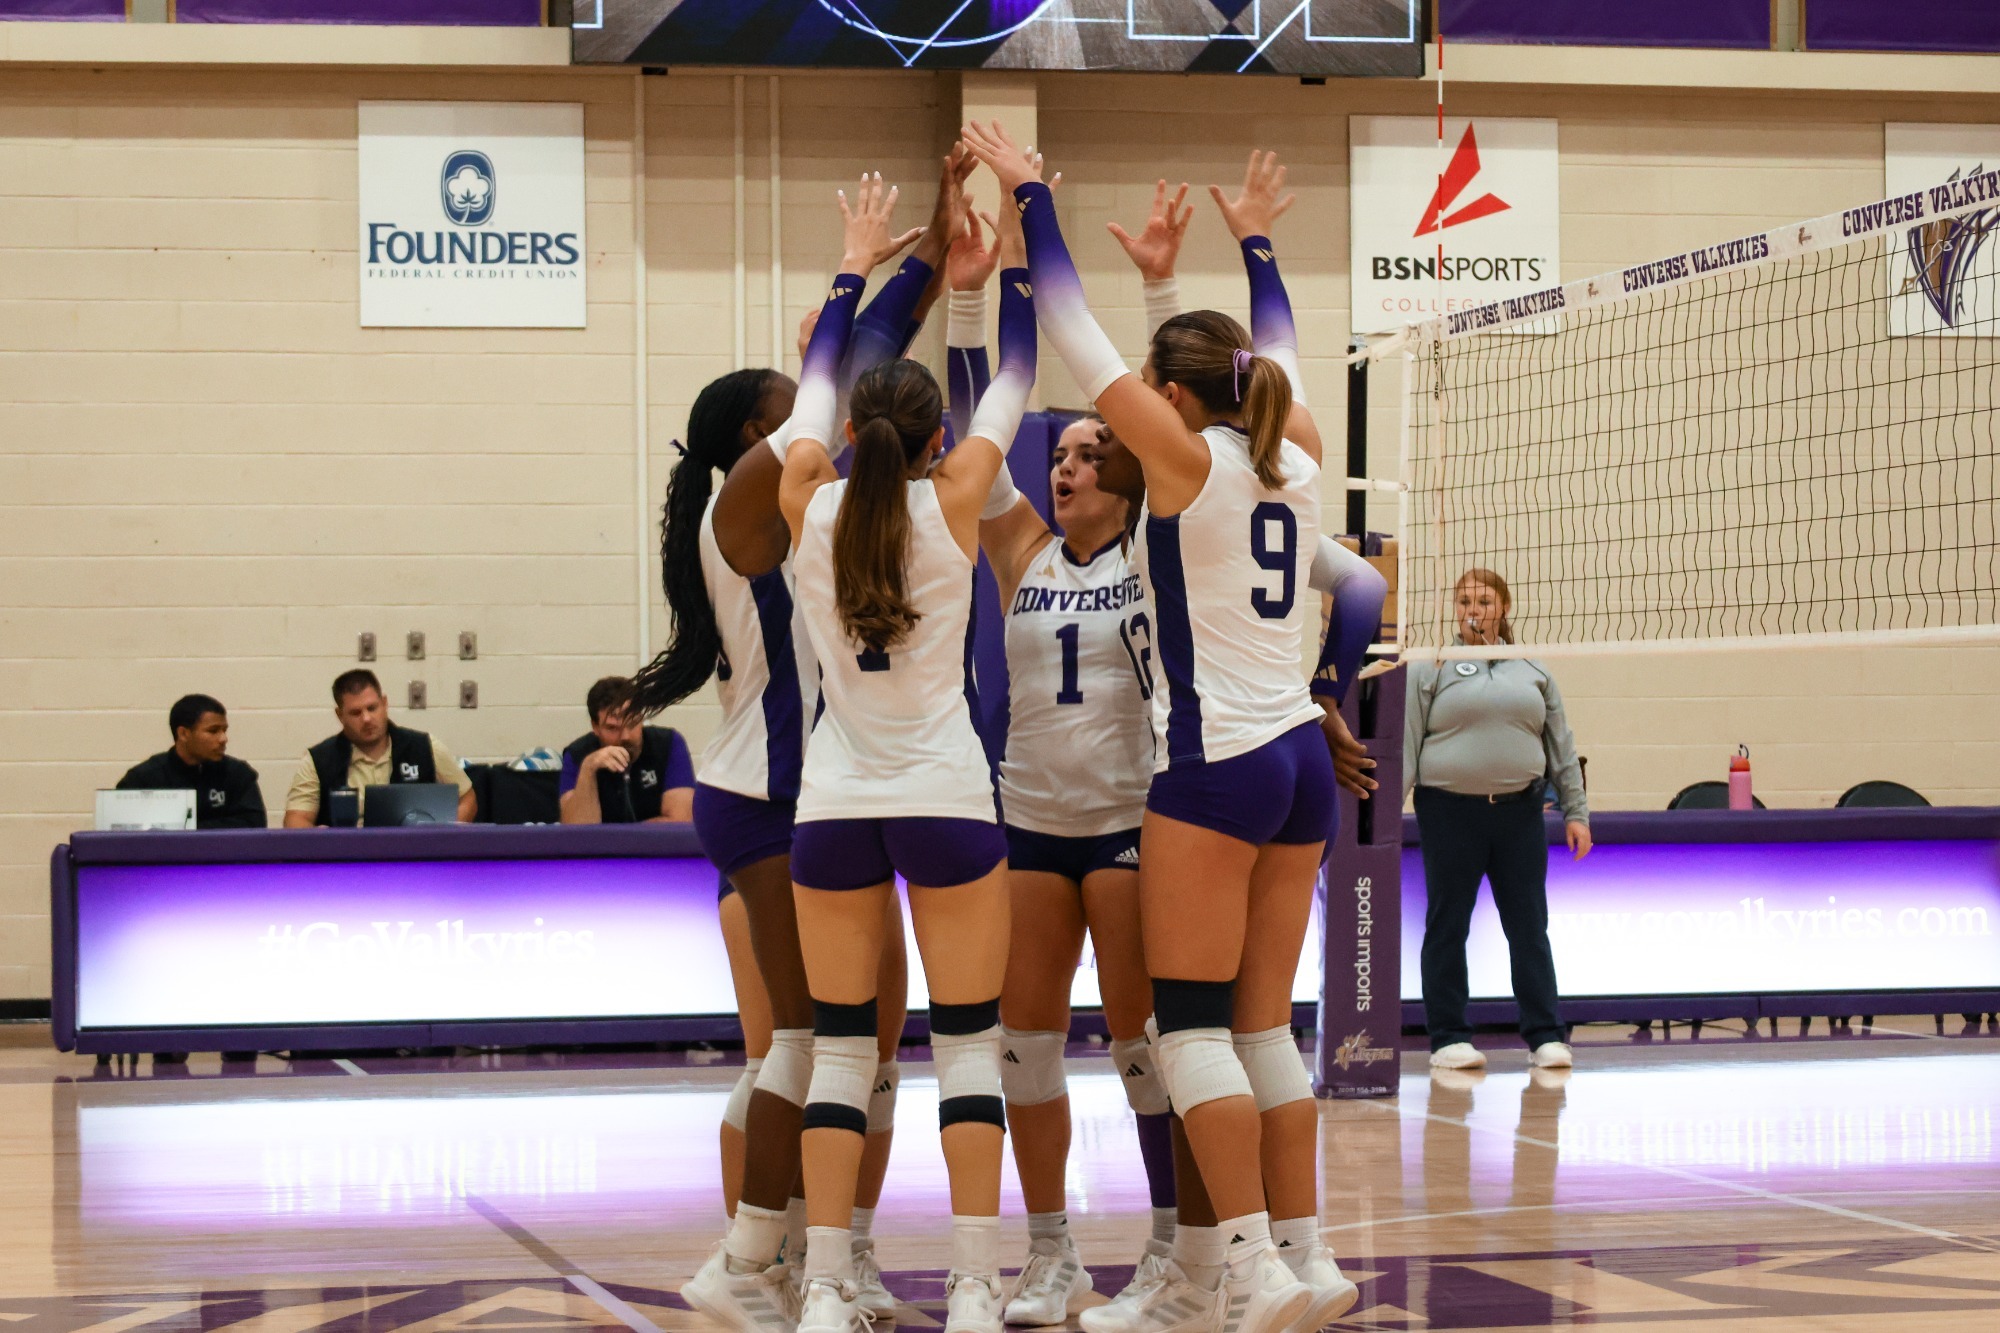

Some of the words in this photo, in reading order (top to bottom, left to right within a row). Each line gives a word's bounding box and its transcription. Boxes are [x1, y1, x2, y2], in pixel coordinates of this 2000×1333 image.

[1842, 191, 1923, 237] CONVERSE
[367, 223, 580, 265] FOUNDERS
[1623, 254, 1688, 292] CONVERSE
[1691, 234, 1768, 274] VALKYRIES
[368, 269, 445, 279] FEDERAL
[453, 269, 515, 279] CREDIT
[526, 269, 578, 279] UNION
[1447, 302, 1501, 334] CONVERSE
[1502, 286, 1566, 321] VALKYRIES
[1250, 501, 1297, 619] 9
[1056, 623, 1083, 705] 1
[1119, 611, 1154, 701] 12
[400, 762, 419, 776] CU
[1354, 876, 1374, 936] sports
[257, 916, 596, 970] #GoValkyries
[1354, 938, 1373, 1012] imports
